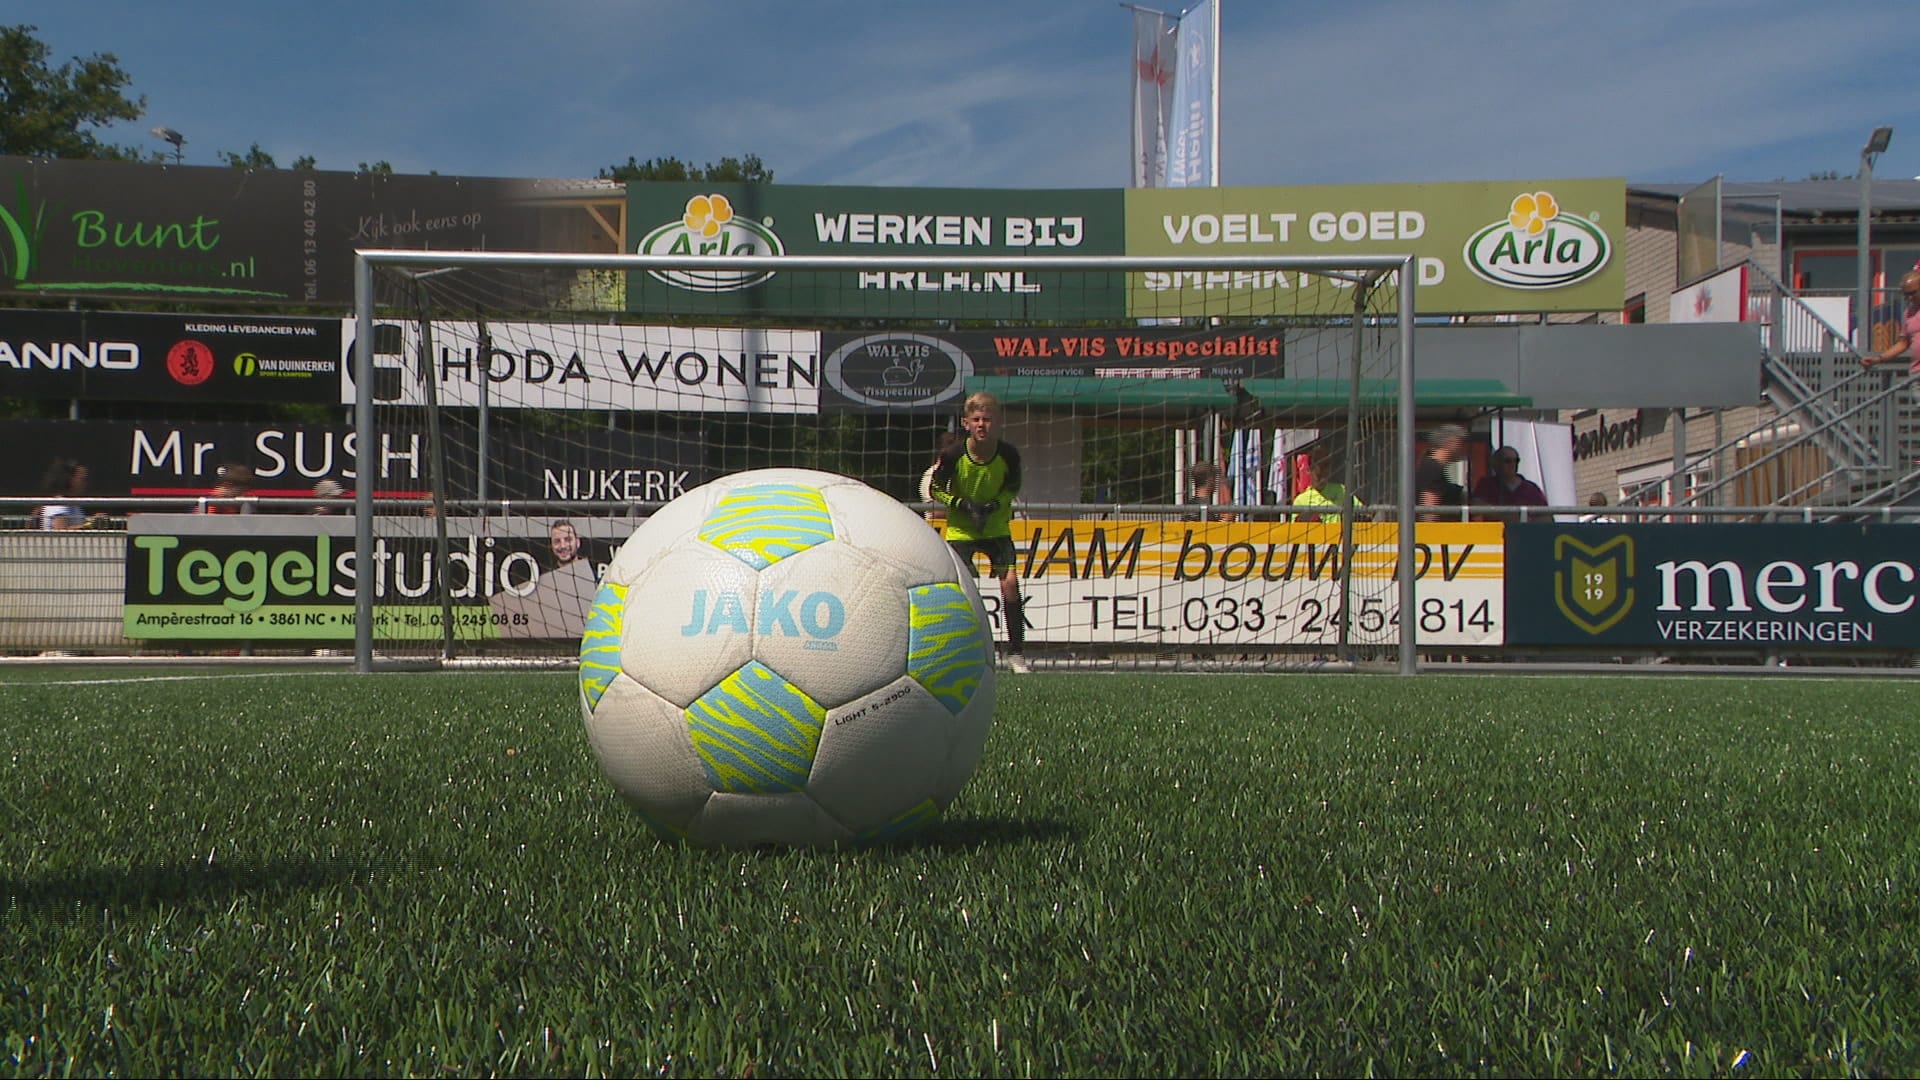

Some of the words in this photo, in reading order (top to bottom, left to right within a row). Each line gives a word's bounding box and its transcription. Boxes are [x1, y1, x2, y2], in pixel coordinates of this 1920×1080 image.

[303, 180, 317, 197] 80
[304, 200, 317, 217] 42
[72, 208, 220, 252] Bunt
[304, 219, 317, 236] 40
[349, 211, 389, 241] Kijk
[393, 208, 422, 234] ook
[425, 216, 458, 232] eens
[462, 211, 483, 232] op
[813, 213, 991, 246] WERKEN
[1005, 217, 1084, 247] BIJ
[1163, 213, 1297, 244] VOELT
[1309, 211, 1426, 242] GOED
[304, 239, 317, 255] 13
[1489, 228, 1582, 265] Arla
[304, 259, 317, 275] 06
[185, 323, 227, 333] KLEDING
[228, 325, 293, 336] LEVERANCIER
[294, 327, 318, 336] VAN:
[0, 341, 139, 370] ANNO
[865, 345, 931, 358] WAL-VIS
[993, 337, 1107, 358] WAL-VIS
[1116, 335, 1281, 361] Visspecialist
[259, 360, 278, 371] VAN
[279, 360, 336, 373] DUINKERKEN
[442, 347, 592, 385] HODA
[617, 349, 817, 389] WONEN
[131, 430, 227, 475] Mr.
[544, 468, 690, 501] NIJKERK
[1173, 528, 1360, 582] bouw
[134, 533, 540, 611] Tegelstudio
[1584, 573, 1604, 586] 19
[1584, 587, 1604, 600] 19
[1655, 560, 1915, 614] merc
[136, 612, 236, 628] Ampèrestraat
[239, 613, 254, 625] 16
[269, 613, 300, 625] 3861
[304, 613, 326, 625] NC
[404, 614, 426, 627] Tel.
[461, 614, 487, 626] 245
[491, 614, 509, 626] 08
[512, 614, 529, 626] 85
[681, 589, 846, 640] JAKO
[1656, 620, 1873, 642] VERZEKERINGEN
[834, 708, 867, 727] LIGHT
